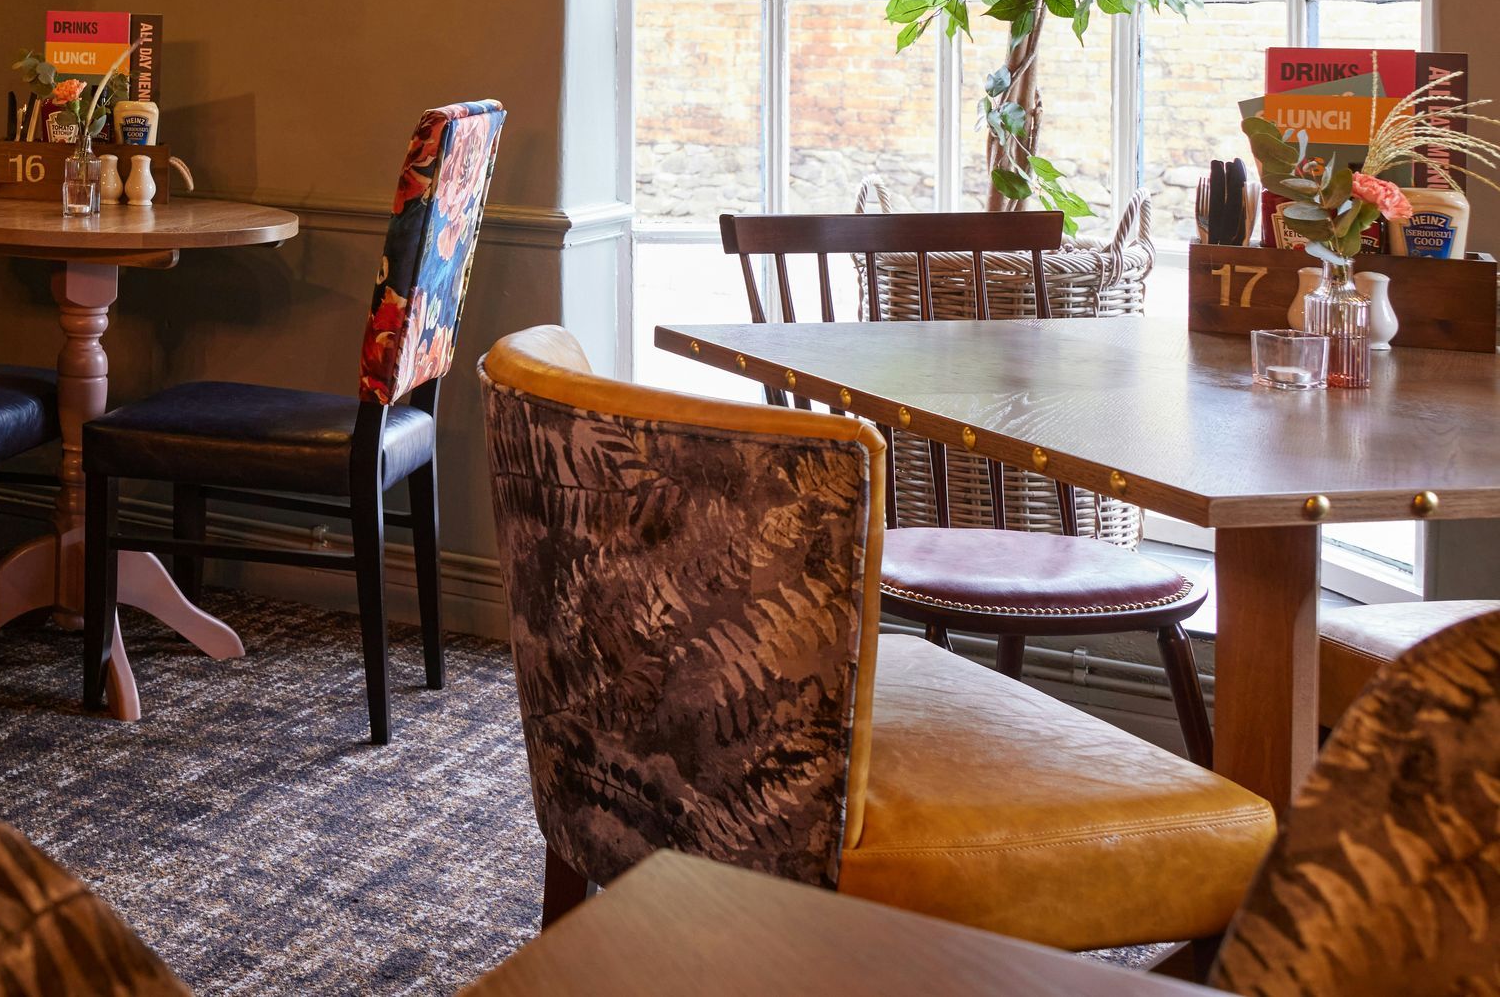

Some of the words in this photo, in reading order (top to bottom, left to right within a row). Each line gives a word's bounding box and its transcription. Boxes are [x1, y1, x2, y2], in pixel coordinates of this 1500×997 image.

[53, 21, 98, 35] DRINKS
[140, 23, 153, 45] ALL
[53, 51, 96, 65] LUNCH
[139, 48, 152, 69] DAY
[1281, 63, 1359, 81] DRINKS
[125, 117, 146, 125] HEINZ
[1277, 109, 1351, 130] LUNCH
[8, 154, 46, 183] 16
[1411, 215, 1447, 228] HEINZ
[1414, 237, 1444, 247] GOOD
[1211, 264, 1268, 308] 17
